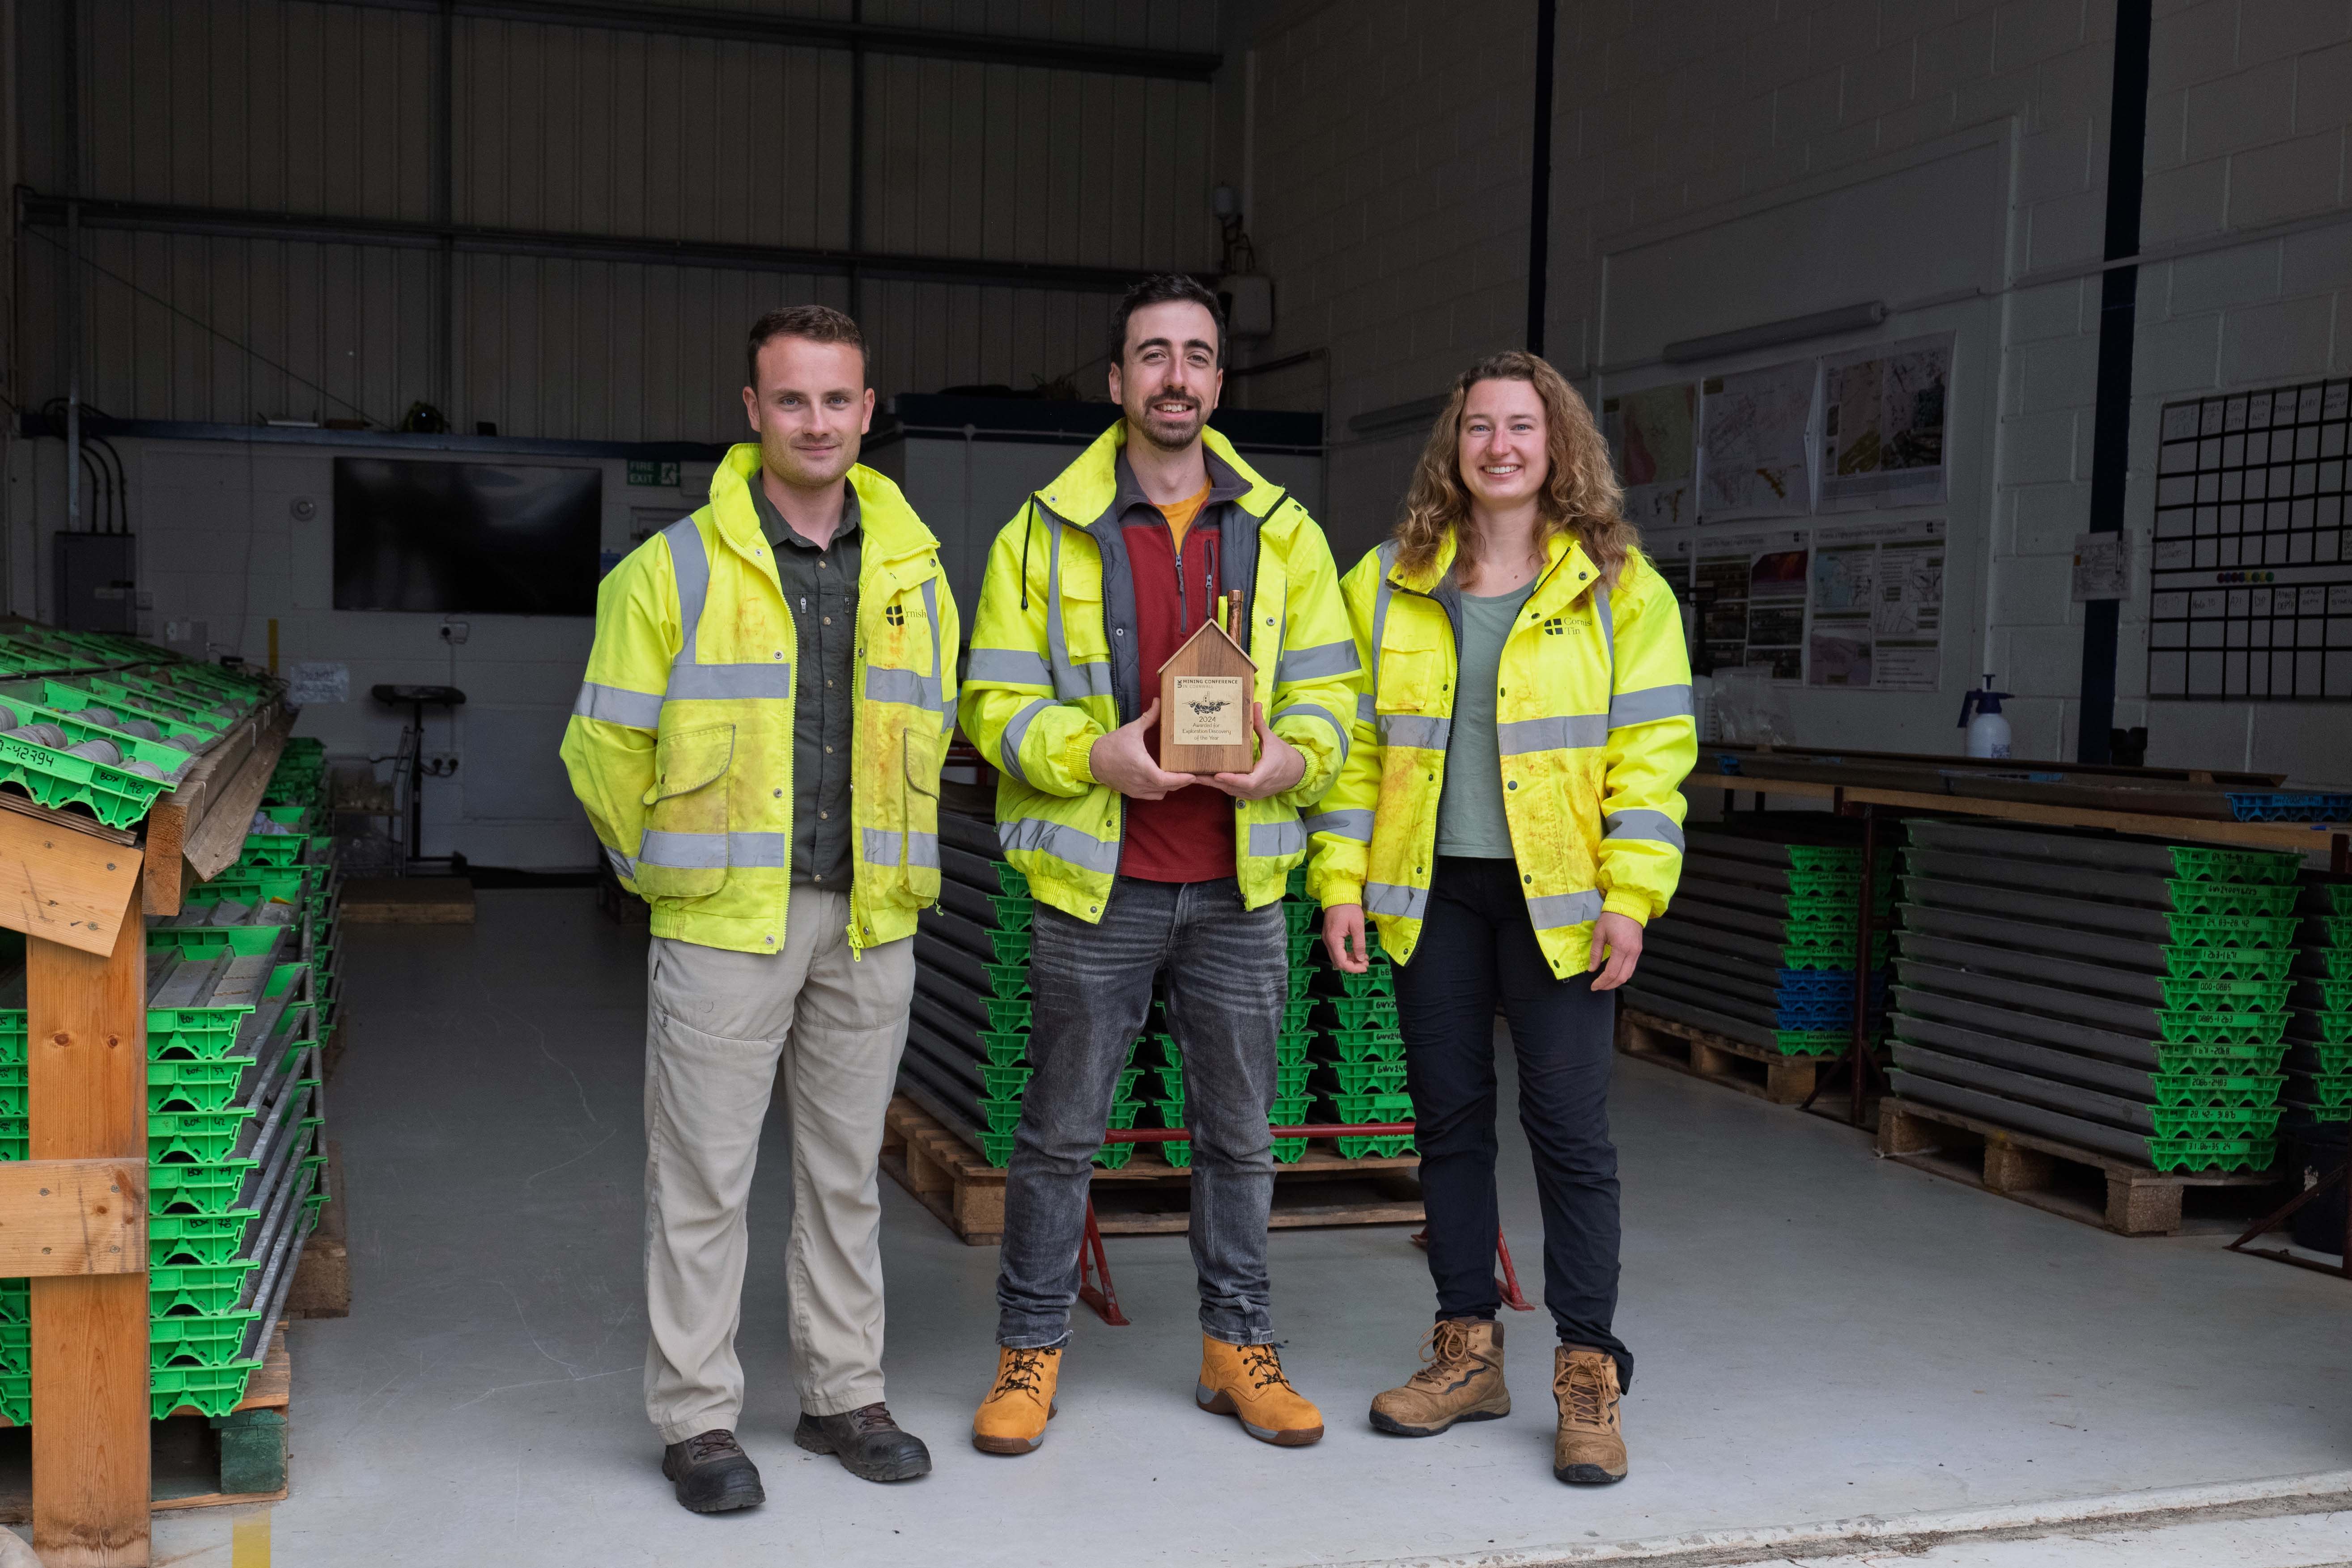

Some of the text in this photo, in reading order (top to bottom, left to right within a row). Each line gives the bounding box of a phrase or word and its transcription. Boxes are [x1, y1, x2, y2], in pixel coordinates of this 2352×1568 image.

[630, 461, 654, 470] FIRE
[629, 474, 653, 483] EXIT
[904, 607, 927, 618] rnish
[1177, 680, 1182, 688] UK
[100, 772, 144, 793] BOX 98
[180, 1014, 195, 1023] BOX
[186, 1067, 202, 1075] BOX
[184, 1118, 201, 1127] BOX
[187, 1168, 204, 1176] BOX
[190, 1219, 208, 1228] BOX
